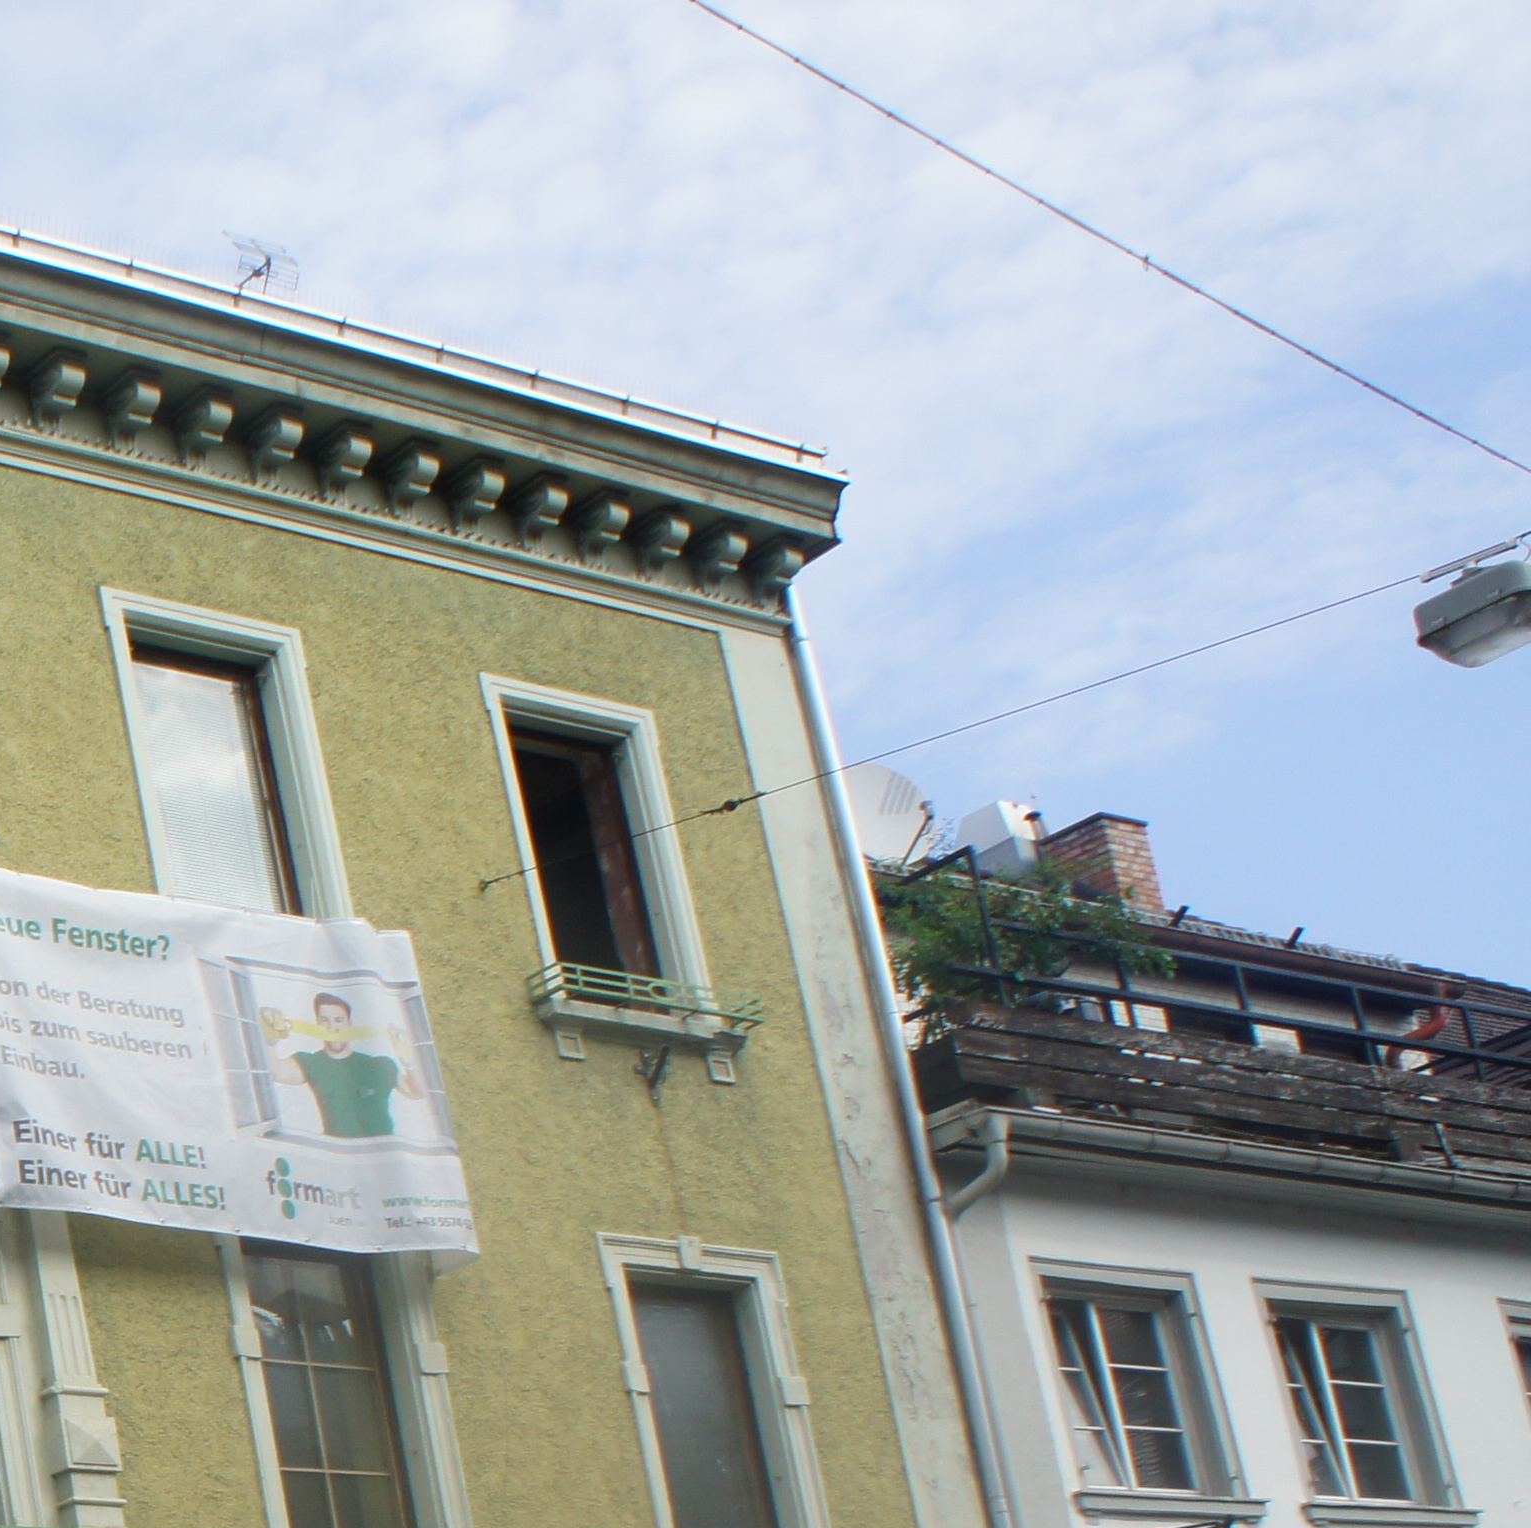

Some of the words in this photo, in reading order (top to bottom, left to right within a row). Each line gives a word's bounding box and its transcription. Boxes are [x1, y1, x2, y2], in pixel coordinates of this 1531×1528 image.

[51, 917, 170, 960] Fenster?
[35, 981, 70, 1005] der
[77, 989, 185, 1029] Beratung
[0, 1044, 86, 1079] Einbau.
[29, 1019, 81, 1042] zum
[87, 1029, 193, 1059] sauberen
[12, 1119, 77, 1152] Einer
[85, 1132, 125, 1160] für
[135, 1139, 206, 1169] ALLE!
[18, 1159, 87, 1190] Einer
[93, 1170, 132, 1199] für
[142, 1178, 226, 1210] ALLES!
